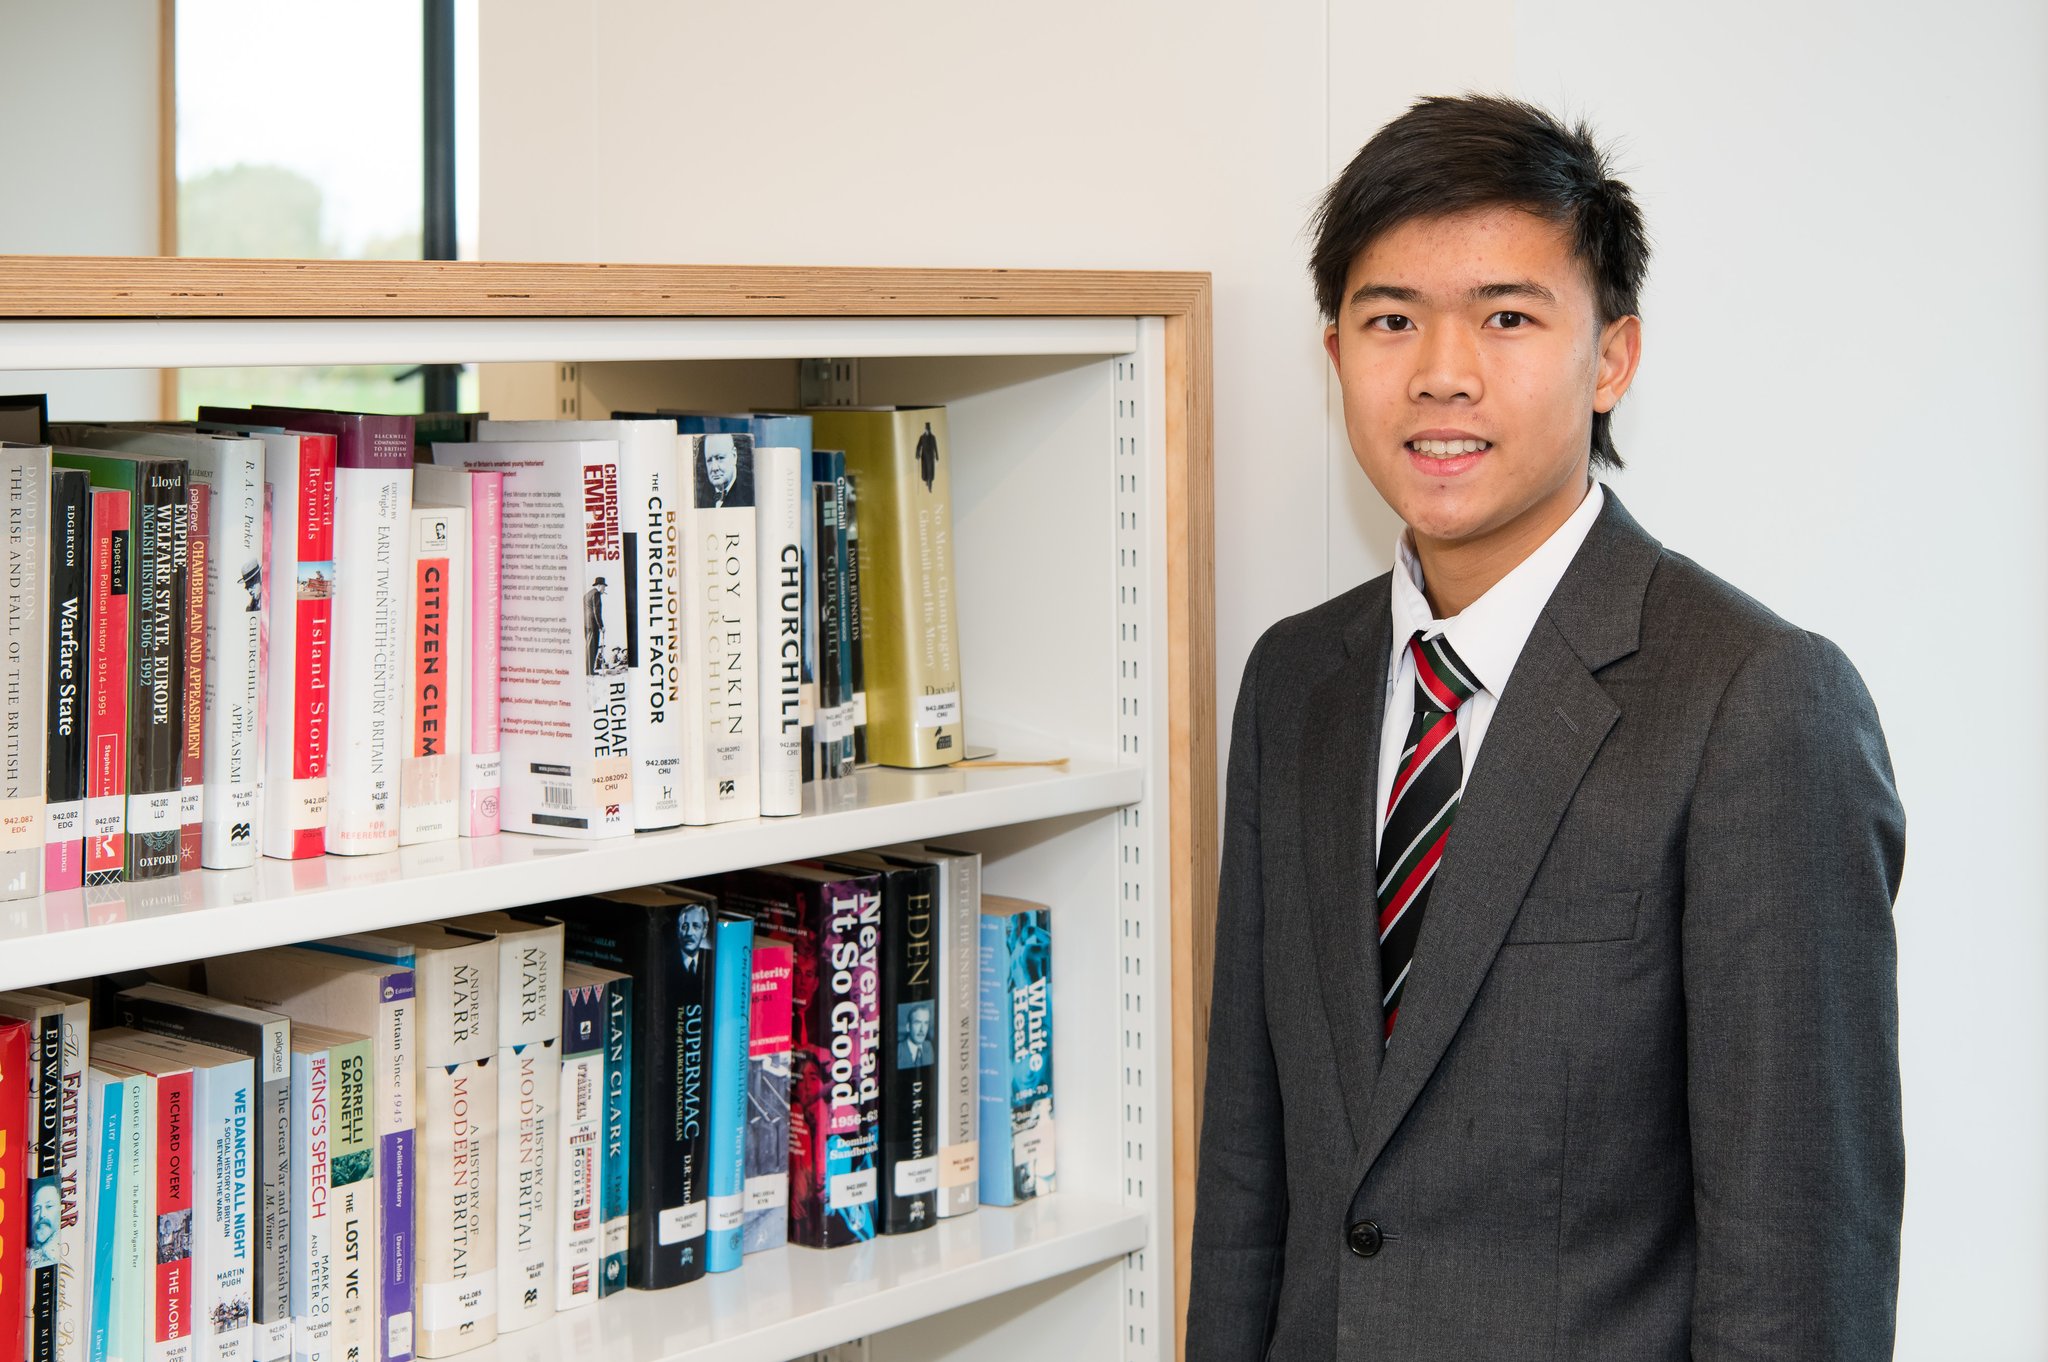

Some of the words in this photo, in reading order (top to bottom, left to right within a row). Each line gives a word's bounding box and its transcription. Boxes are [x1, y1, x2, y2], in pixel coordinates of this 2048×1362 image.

[11, 466, 22, 501] THE
[152, 476, 181, 489] Lloyd
[307, 468, 320, 540] Reynolds
[324, 481, 332, 525] David
[377, 485, 390, 517] Wrigley
[487, 484, 497, 526] Lukacs
[837, 477, 846, 530] Churchill
[10, 508, 21, 544] RISE
[142, 504, 154, 555] ENGLISH
[189, 489, 199, 532] palgrave
[244, 515, 254, 549] Parker
[583, 464, 607, 562] EMPIRE
[604, 463, 620, 561] CHURCHILL'S
[66, 505, 75, 567] EDGERTON
[101, 537, 109, 570] British
[114, 536, 123, 574] Aspects
[156, 504, 172, 585] WELFARE
[171, 504, 187, 573] EMPIRE,
[377, 527, 390, 564] EARLY
[666, 511, 677, 578] BORIS
[919, 510, 932, 571] Churchill
[936, 531, 946, 571] More
[10, 551, 20, 588] AND
[114, 577, 122, 587] of
[648, 496, 663, 627] CHURCHILL
[725, 534, 741, 598] ROY
[100, 574, 109, 614] Political
[142, 559, 153, 612] HISTORY
[191, 541, 204, 632] CHAMBERLAIN
[827, 555, 837, 656] CHURCHILL
[9, 595, 20, 636] FALL
[98, 618, 108, 652] History
[153, 589, 171, 651] STATE,
[423, 567, 440, 675] CITIZEN
[706, 534, 722, 733] CHURCHILL
[850, 585, 860, 641] REYNOLDS
[937, 577, 950, 671] Champagne
[9, 643, 20, 667] OF
[60, 597, 79, 680] Warfare
[190, 636, 201, 663] AND
[248, 616, 257, 704] CHURCHILL
[311, 618, 326, 689] Island
[373, 568, 389, 717] TWENTIETH-CENTURY
[667, 587, 680, 702] JOHNSON
[781, 544, 799, 734] CHURCHILL
[8, 673, 19, 705] THE
[153, 655, 169, 724] EUROPE
[650, 635, 665, 724] FACTOR
[723, 616, 743, 734] JENKIN
[59, 684, 76, 737] State
[188, 666, 201, 759] APPEASEMENT
[534, 699, 558, 707] Washington
[7, 713, 19, 779] BRITISH
[371, 722, 384, 774] BRITAIN
[540, 730, 556, 738] Sunday
[556, 731, 573, 739] Express
[593, 704, 610, 757] TOYE
[592, 773, 628, 784] 942.082092
[4, 815, 33, 825] 942.082
[12, 825, 27, 834] EDG
[52, 811, 78, 821] 942.082
[58, 821, 73, 830] EDG
[95, 816, 120, 825] 942.082
[101, 825, 114, 833] LEE
[340, 831, 386, 839] REFERENCE
[140, 854, 178, 867] OXFORD
[832, 894, 858, 933] It
[859, 891, 881, 1012] Never
[907, 893, 930, 986] EDEN
[522, 948, 538, 1025] MARR
[537, 950, 547, 1017] ANDREW
[831, 941, 859, 994] So
[960, 925, 969, 1009] HENNESSY
[453, 964, 469, 1044] MARR
[470, 967, 479, 1036] ANDREW
[1014, 985, 1029, 1064] Heat
[1027, 976, 1047, 1072] White
[394, 1009, 404, 1050] Britain
[611, 992, 623, 1061] ALAN
[960, 1016, 970, 1071] WINDS
[275, 1032, 283, 1072] palgrave
[311, 1058, 326, 1066] THE
[394, 1054, 404, 1088] Since
[684, 1005, 702, 1139] SUPERMAC
[831, 1001, 859, 1109] Good
[860, 1016, 880, 1105] Had
[44, 1029, 58, 1129] EDWARD
[235, 1088, 246, 1114] WE
[278, 1086, 288, 1114] The
[341, 1059, 352, 1144] BARNETT
[352, 1055, 363, 1144] CORRELLI
[960, 1076, 969, 1094] OF
[61, 1069, 82, 1168] FATEFUL
[132, 1085, 141, 1130] GEORGE
[169, 1091, 181, 1152] RICHARD
[394, 1093, 403, 1123] 1945
[520, 1058, 534, 1164] MODERN
[609, 1071, 622, 1159] CLARK
[132, 1131, 140, 1175] ORWELL
[224, 1127, 232, 1156] SOCIAL
[235, 1120, 246, 1179] DANCED
[278, 1120, 288, 1157] Great
[453, 1077, 468, 1187] MODERN
[534, 1119, 544, 1187] HISTORY
[830, 1144, 878, 1160] Sandbrook
[837, 1134, 875, 1147] Dominic
[43, 1138, 56, 1173] VII
[169, 1155, 181, 1200] OVERY
[278, 1159, 288, 1187] War
[470, 1141, 479, 1209] HISTORY
[60, 1169, 79, 1230] YEAR
[234, 1181, 246, 1211] ALL
[278, 1190, 288, 1214] and
[311, 1141, 326, 1219] SPEECH
[345, 1192, 354, 1213] THE
[395, 1178, 403, 1208] History
[534, 1192, 543, 1211] OF
[234, 1216, 246, 1259] NIGHT
[265, 1213, 275, 1250] Winter
[278, 1219, 288, 1241] the
[345, 1219, 358, 1261] LOST
[470, 1215, 479, 1235] OF
[168, 1268, 179, 1294] THE
[217, 1268, 245, 1280] MARTIN
[222, 1279, 241, 1288] PUGH
[278, 1244, 288, 1292] British
[311, 1262, 320, 1299] PETER
[321, 1255, 329, 1292] MARK
[42, 1271, 50, 1318] KEITH
